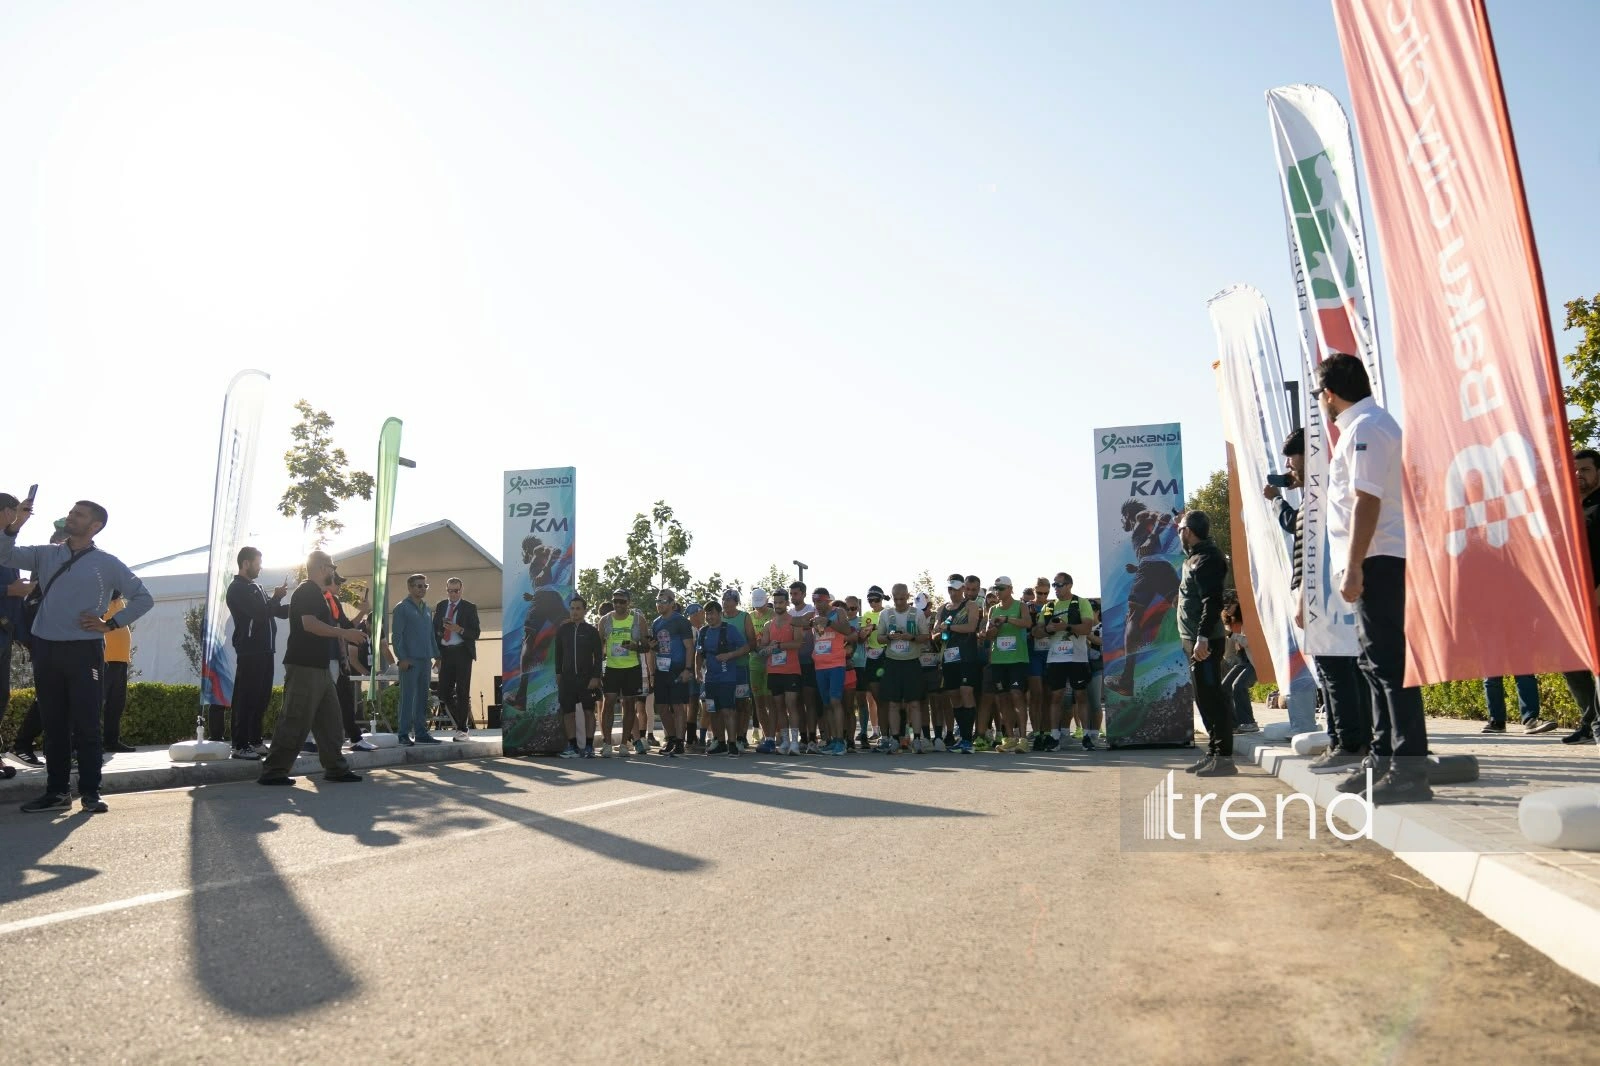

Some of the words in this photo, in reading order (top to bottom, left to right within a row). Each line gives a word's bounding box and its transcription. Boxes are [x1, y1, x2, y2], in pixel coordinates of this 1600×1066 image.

[1101, 461, 1154, 480] 192
[1130, 478, 1179, 497] KM
[508, 501, 550, 518] 192
[530, 517, 569, 533] KM
